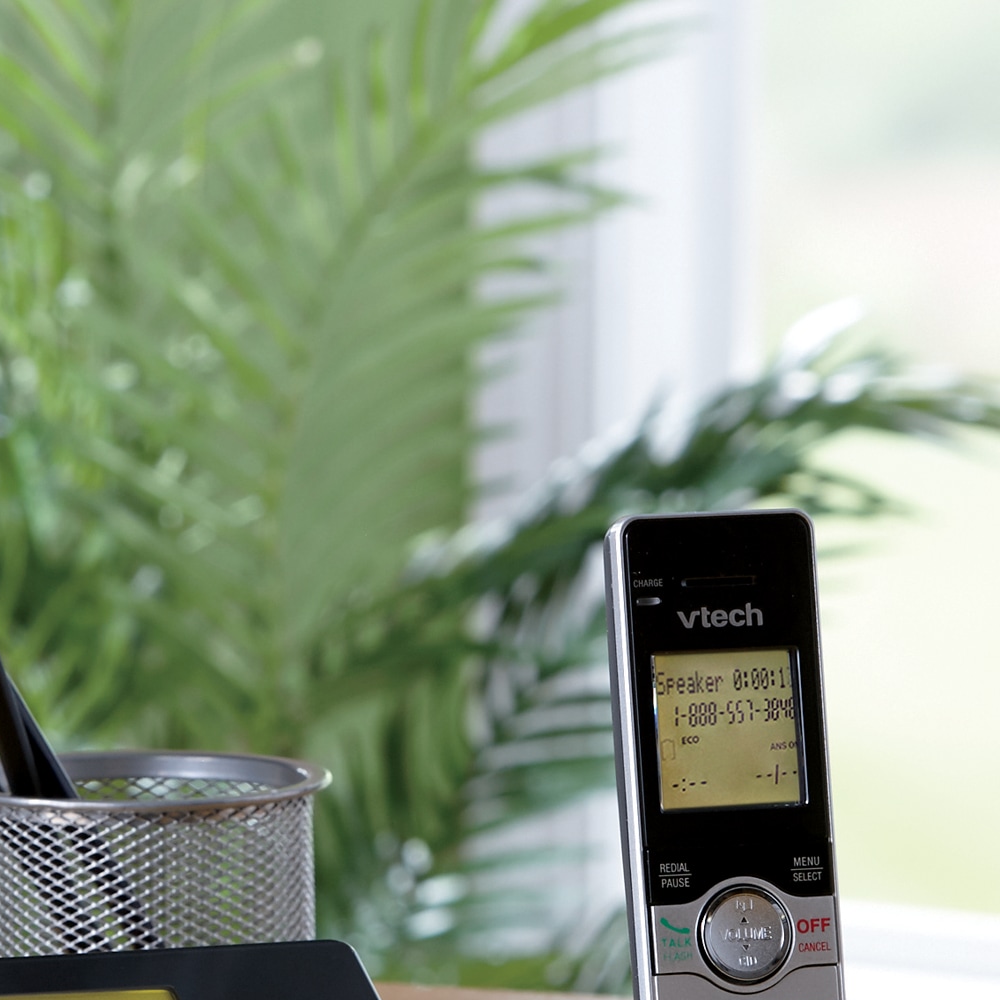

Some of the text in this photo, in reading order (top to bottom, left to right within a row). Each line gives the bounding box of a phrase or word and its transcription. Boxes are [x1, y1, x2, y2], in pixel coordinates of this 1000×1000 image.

[633, 579, 663, 588] CHARGE
[677, 602, 764, 629] vtech
[657, 667, 792, 696] Speaker 0:00:1
[682, 736, 700, 745] ECO
[770, 742, 787, 751] ANS
[793, 856, 820, 867] MENU
[659, 862, 690, 873] REDIAL
[793, 871, 822, 882] SELECT
[661, 878, 690, 888] PAUSE
[797, 918, 831, 934] OFF
[722, 926, 772, 941] VOLUME
[662, 938, 692, 948] TALK
[798, 942, 831, 953] CANCEL
